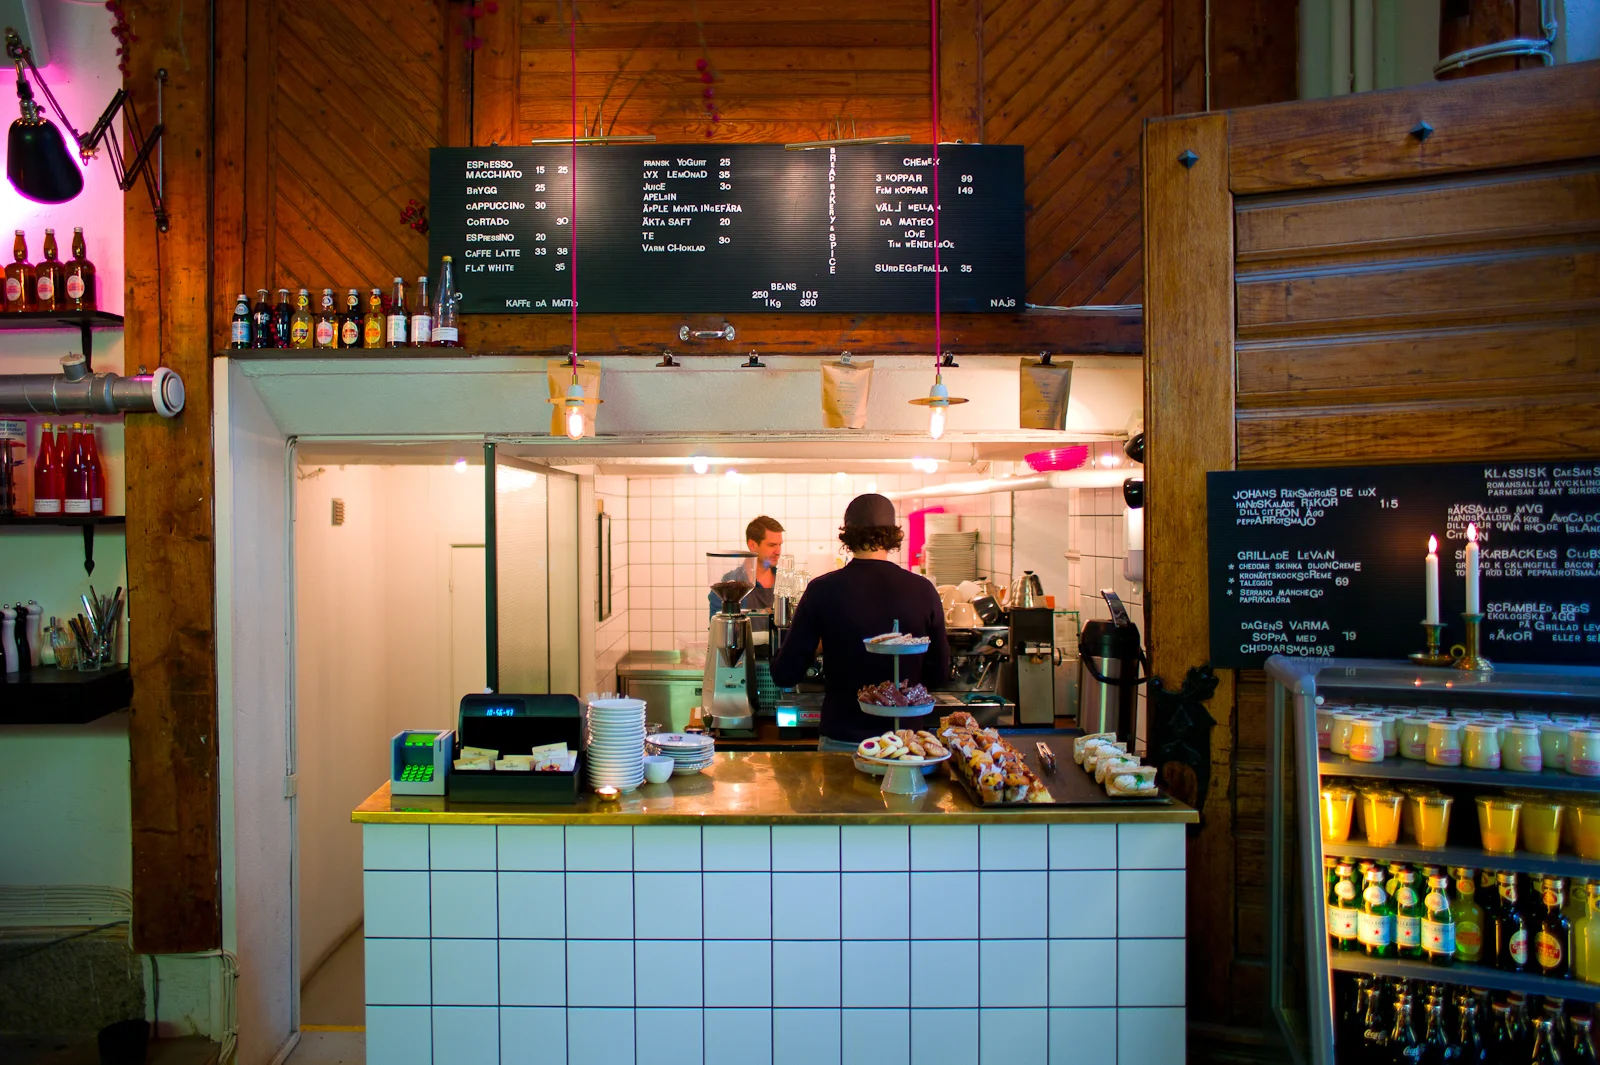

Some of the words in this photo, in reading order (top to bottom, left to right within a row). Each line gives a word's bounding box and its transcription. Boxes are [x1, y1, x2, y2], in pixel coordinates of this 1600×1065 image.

[467, 161, 513, 169] ESPRESSO
[677, 158, 707, 167] YOGURT
[720, 158, 731, 167] 25
[828, 147, 836, 182] BREAD
[536, 166, 545, 174] 15
[558, 166, 568, 174] 25
[643, 170, 659, 179] LYX
[667, 170, 708, 179] LEMONAD
[718, 170, 730, 179] 35
[466, 171, 522, 179] MACCHIATO
[876, 174, 882, 182] 3
[886, 174, 922, 182] KOPPAR
[961, 175, 973, 183] 99
[467, 186, 498, 195] BRYGG
[535, 184, 546, 192] 25
[643, 182, 666, 191] JUICE
[875, 186, 892, 194] FEM
[895, 186, 928, 194] KOPPAR
[958, 186, 974, 194] 149
[643, 193, 677, 201] APELSIN
[466, 202, 525, 210] CAPPUCCINO
[535, 202, 546, 210] 30
[643, 203, 669, 213] ÄPPLE
[673, 204, 698, 213] MYNTA
[467, 217, 509, 226] CORTADO
[556, 217, 569, 226] 30
[642, 216, 666, 226] ÄKTA
[668, 218, 692, 226] SAFT
[720, 218, 730, 226] 20
[880, 218, 892, 226] DA
[899, 218, 934, 226] MATTEO
[466, 234, 515, 242] ESPRESSINO
[535, 233, 547, 241] 20
[642, 232, 654, 240] TE
[905, 230, 925, 238] LOVE
[642, 244, 665, 252] VARM
[667, 244, 706, 252] CHOKLAD
[888, 240, 901, 248] TIM
[465, 249, 491, 258] CAFFE
[495, 249, 521, 258] LATTE
[534, 248, 547, 256] 33
[557, 247, 568, 255] 38
[828, 233, 837, 274] SPICE
[465, 264, 485, 273] FLAT
[488, 264, 515, 272] WHITE
[555, 262, 566, 272] 35
[960, 264, 972, 273] 35
[771, 282, 797, 291] BEANS
[752, 290, 769, 299] 250
[802, 290, 819, 299] 105
[506, 299, 531, 308] KAFFE
[536, 299, 547, 308] DA
[800, 299, 817, 307] 350
[1484, 467, 1547, 479] KLASSISK
[1553, 467, 1592, 478] CAESAR
[1486, 480, 1550, 489] ROMANSALLAD
[1233, 489, 1277, 500] JOHANS
[1340, 488, 1353, 497] DE
[1358, 487, 1377, 497] LUX
[1488, 488, 1534, 497] PARMESAN
[1301, 498, 1338, 508] RÄKOR
[1239, 508, 1259, 516] DILL
[1262, 508, 1300, 518] CITRON
[1448, 504, 1507, 515] RÄKSALLAD
[1516, 504, 1544, 514] MVG
[1496, 522, 1519, 532] OWN
[1524, 523, 1558, 533] RHODE
[1237, 551, 1289, 561] GRILLADE
[1297, 551, 1335, 560] LEVAIN
[1564, 561, 1593, 569] BACON
[1486, 568, 1502, 576] RÖD
[1505, 568, 1522, 576] LÖK
[1335, 577, 1349, 586] 69
[1278, 589, 1323, 598] MANCHEGO
[1486, 603, 1551, 613] SCRAMBLED
[1560, 603, 1589, 614] EGGS
[1551, 612, 1575, 621] ÄGG
[1241, 621, 1283, 631] DAGENS
[1289, 621, 1330, 630] VARMA
[1519, 620, 1530, 628] PÅ
[1534, 621, 1578, 631] GRILLAD
[1252, 633, 1288, 642] SOPPA
[1296, 635, 1317, 643] MED
[1489, 629, 1532, 641] RÄKOR
[1552, 634, 1580, 642] ELLER
